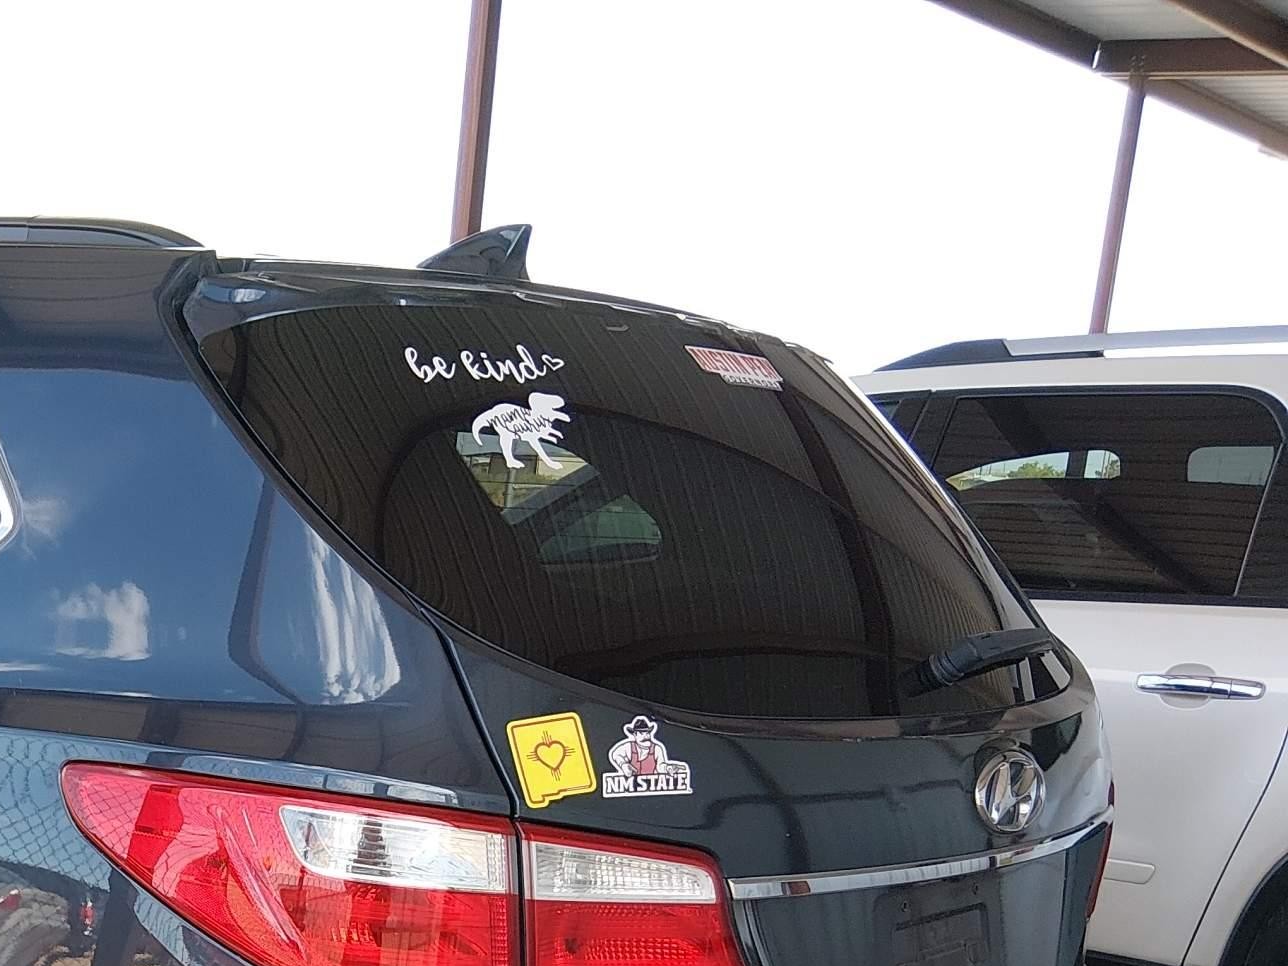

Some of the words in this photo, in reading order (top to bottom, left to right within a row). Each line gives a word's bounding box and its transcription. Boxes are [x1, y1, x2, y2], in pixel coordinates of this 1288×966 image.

[405, 347, 455, 383] be
[460, 344, 546, 384] kind
[487, 406, 532, 429] mama
[606, 776, 634, 793] NM
[636, 773, 687, 791] STATE
